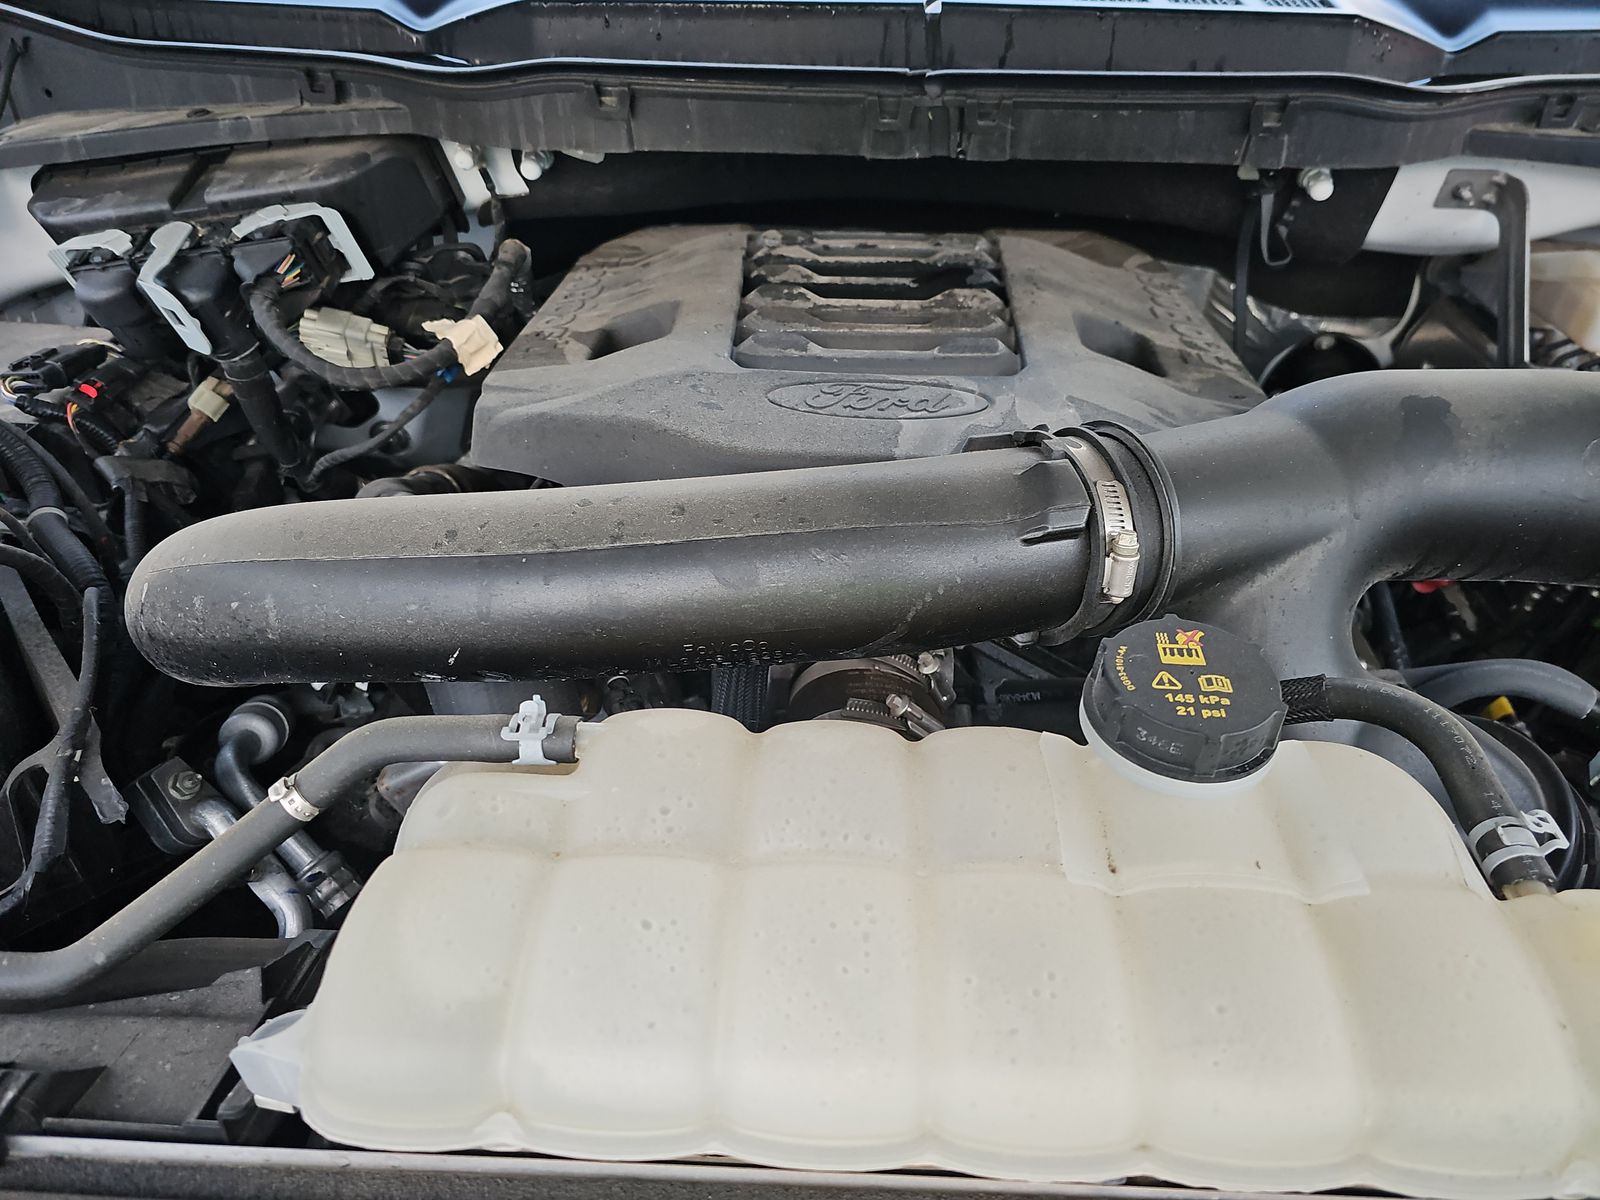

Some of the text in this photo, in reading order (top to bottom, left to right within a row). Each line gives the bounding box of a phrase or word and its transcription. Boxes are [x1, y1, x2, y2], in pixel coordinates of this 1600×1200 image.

[804, 382, 953, 413] Ford
[1165, 693, 1231, 706] 145 kPa
[1175, 705, 1226, 719] 21 psi
